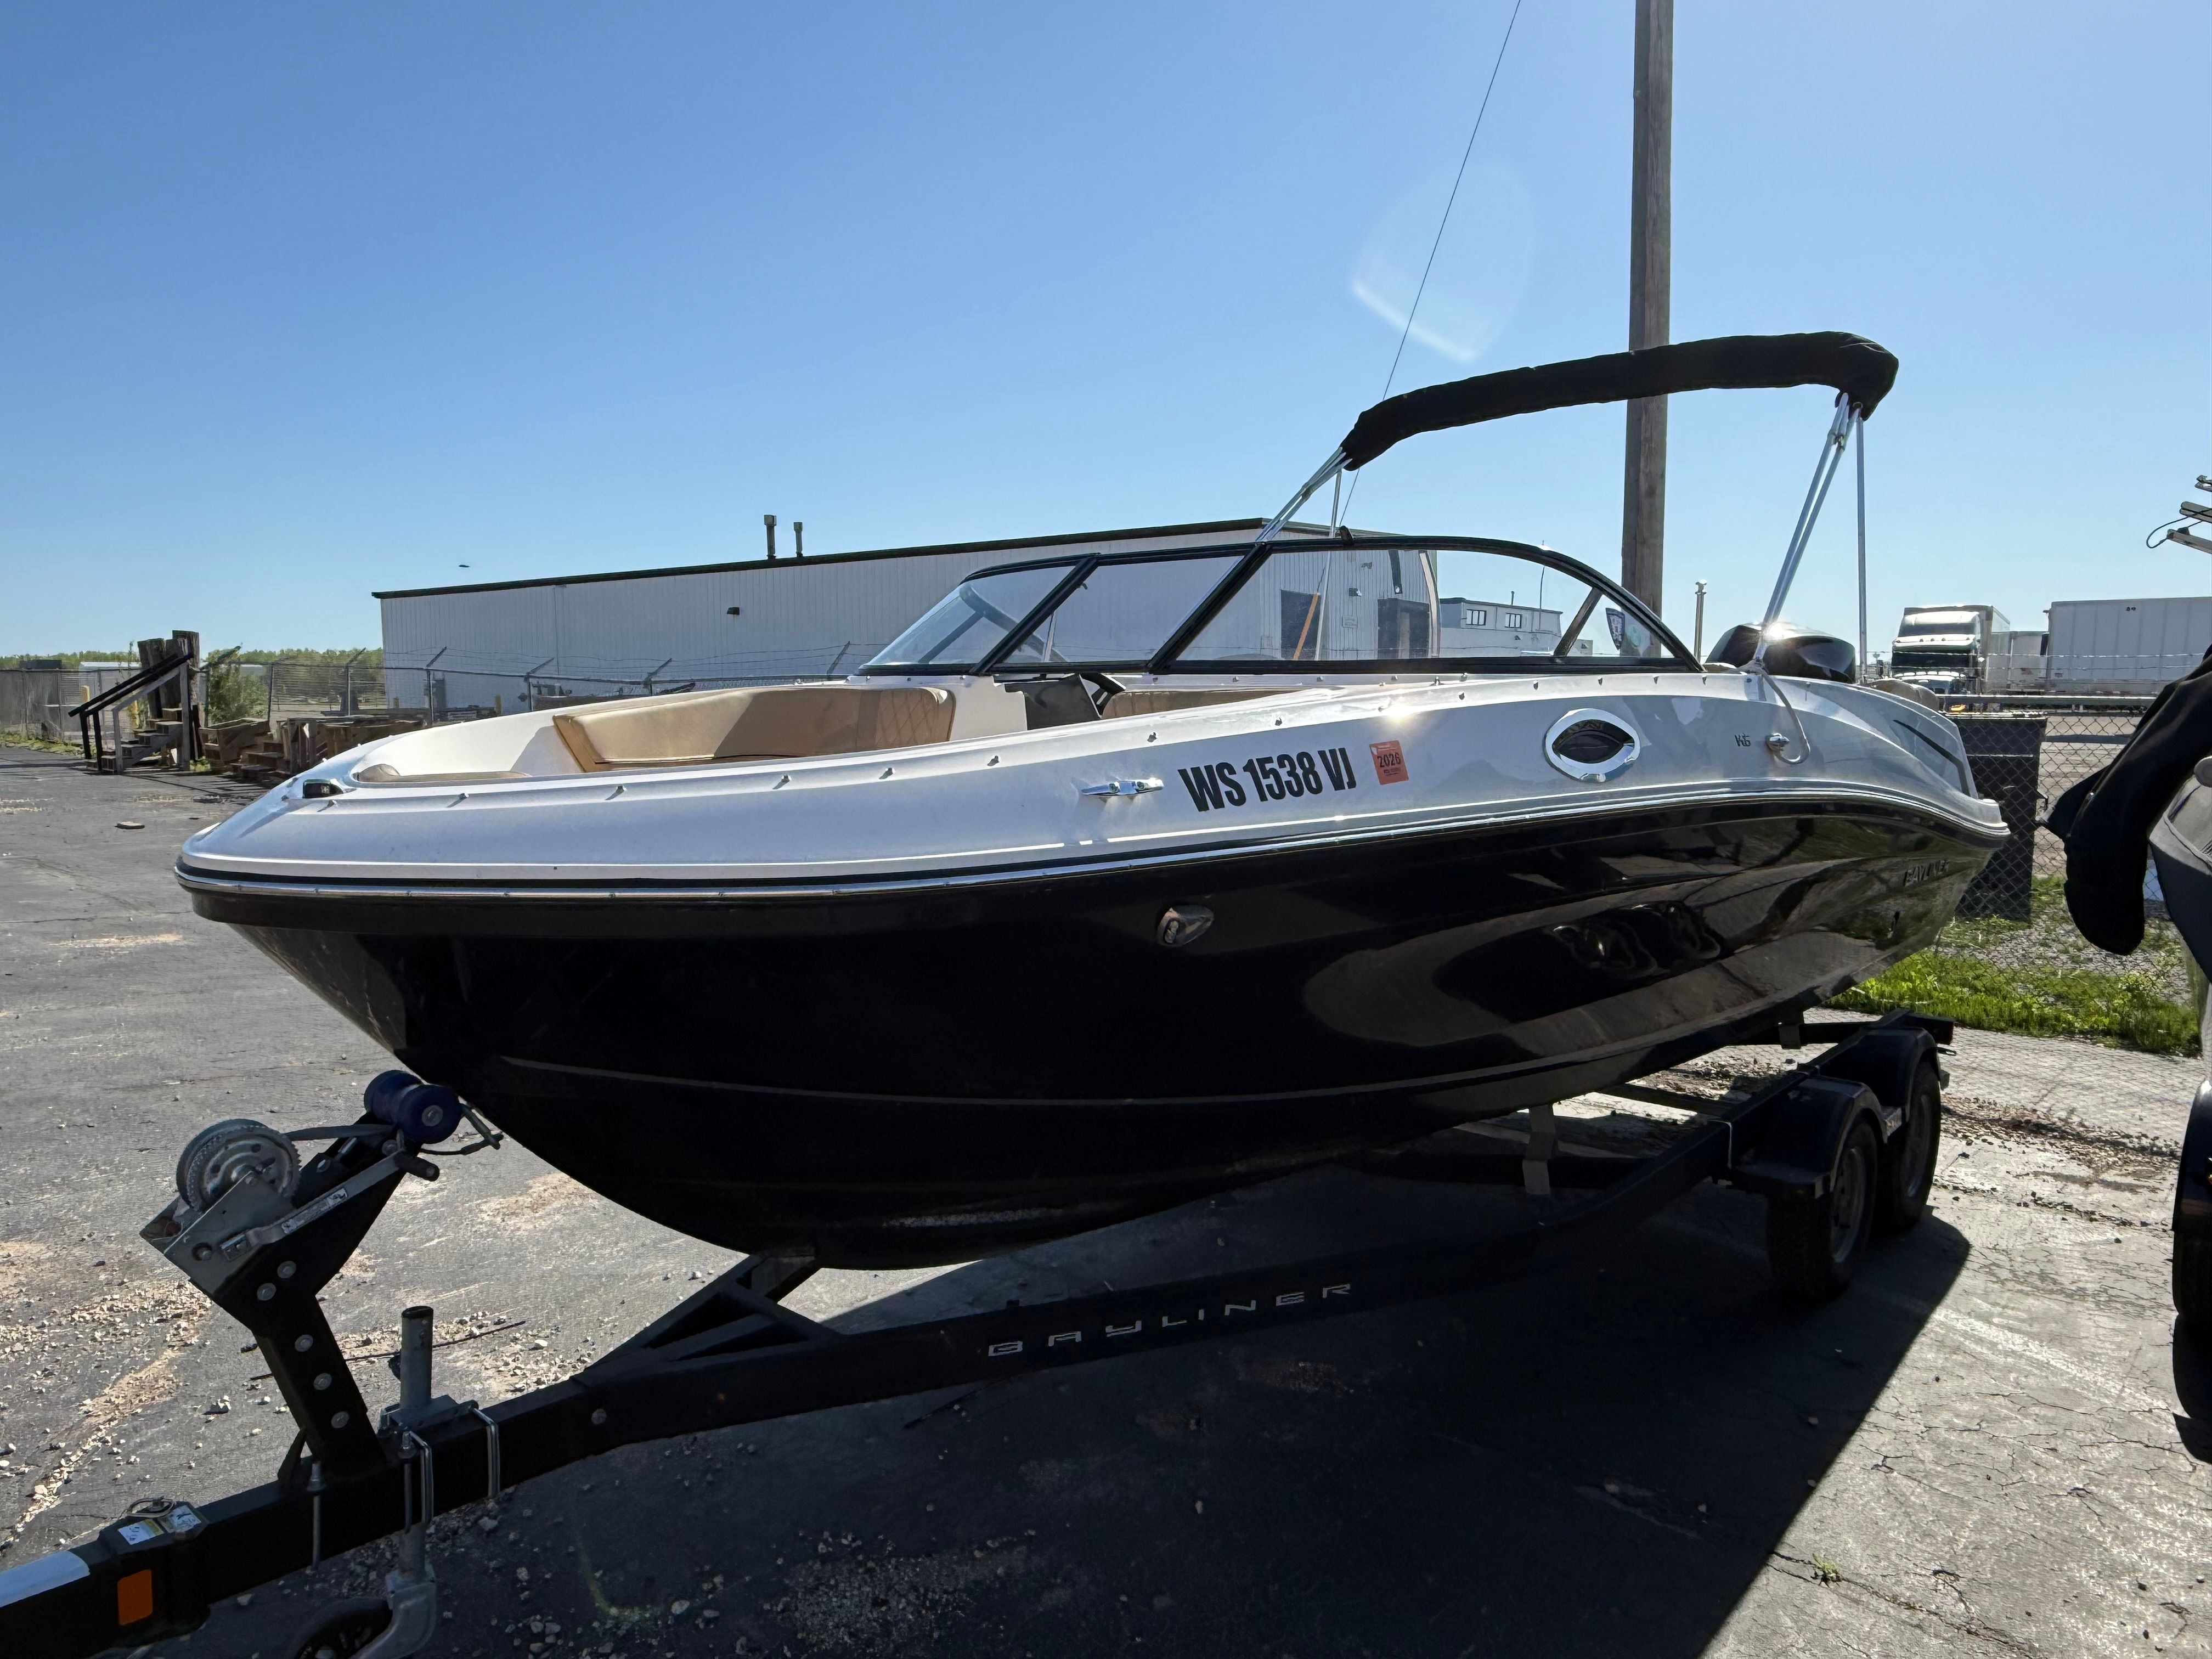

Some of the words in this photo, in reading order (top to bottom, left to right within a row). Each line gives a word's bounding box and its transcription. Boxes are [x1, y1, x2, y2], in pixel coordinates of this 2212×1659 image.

[1177, 761, 1246, 812] WS
[1243, 751, 1323, 802] 1538
[1318, 748, 1357, 791] VJ
[988, 1284, 1351, 1356] BAYLINER
